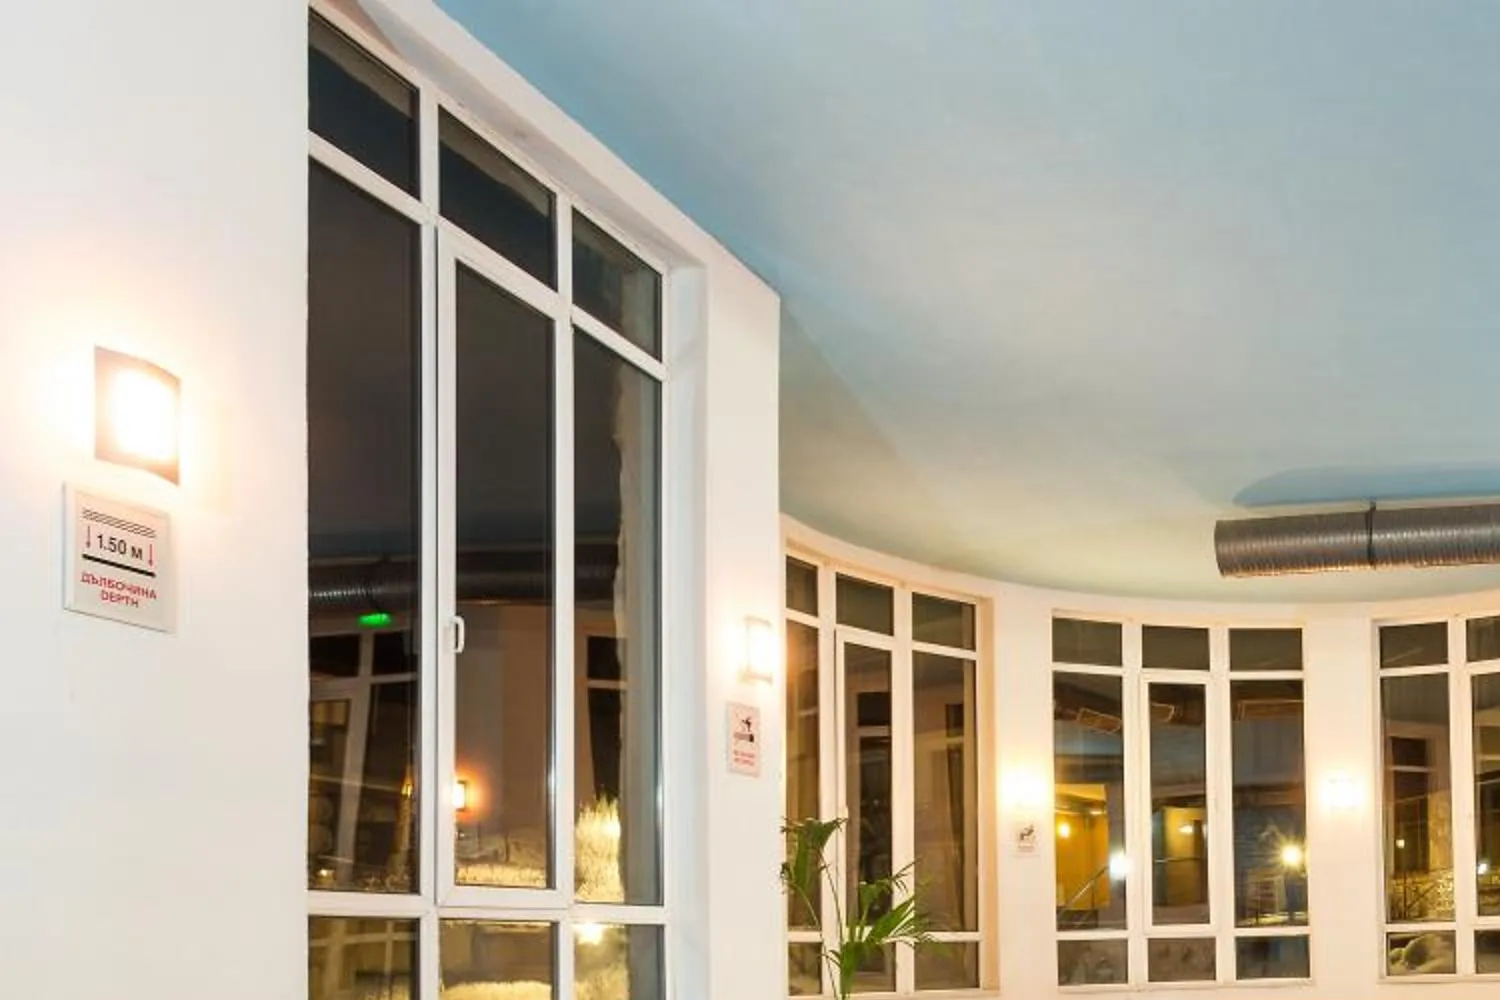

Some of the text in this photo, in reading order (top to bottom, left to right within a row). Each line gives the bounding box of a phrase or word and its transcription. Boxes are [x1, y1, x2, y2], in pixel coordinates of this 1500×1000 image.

[97, 534, 127, 556] 1.50
[80, 571, 157, 600] ДЪЛБОЧИНА
[101, 590, 139, 608] DEPTH
